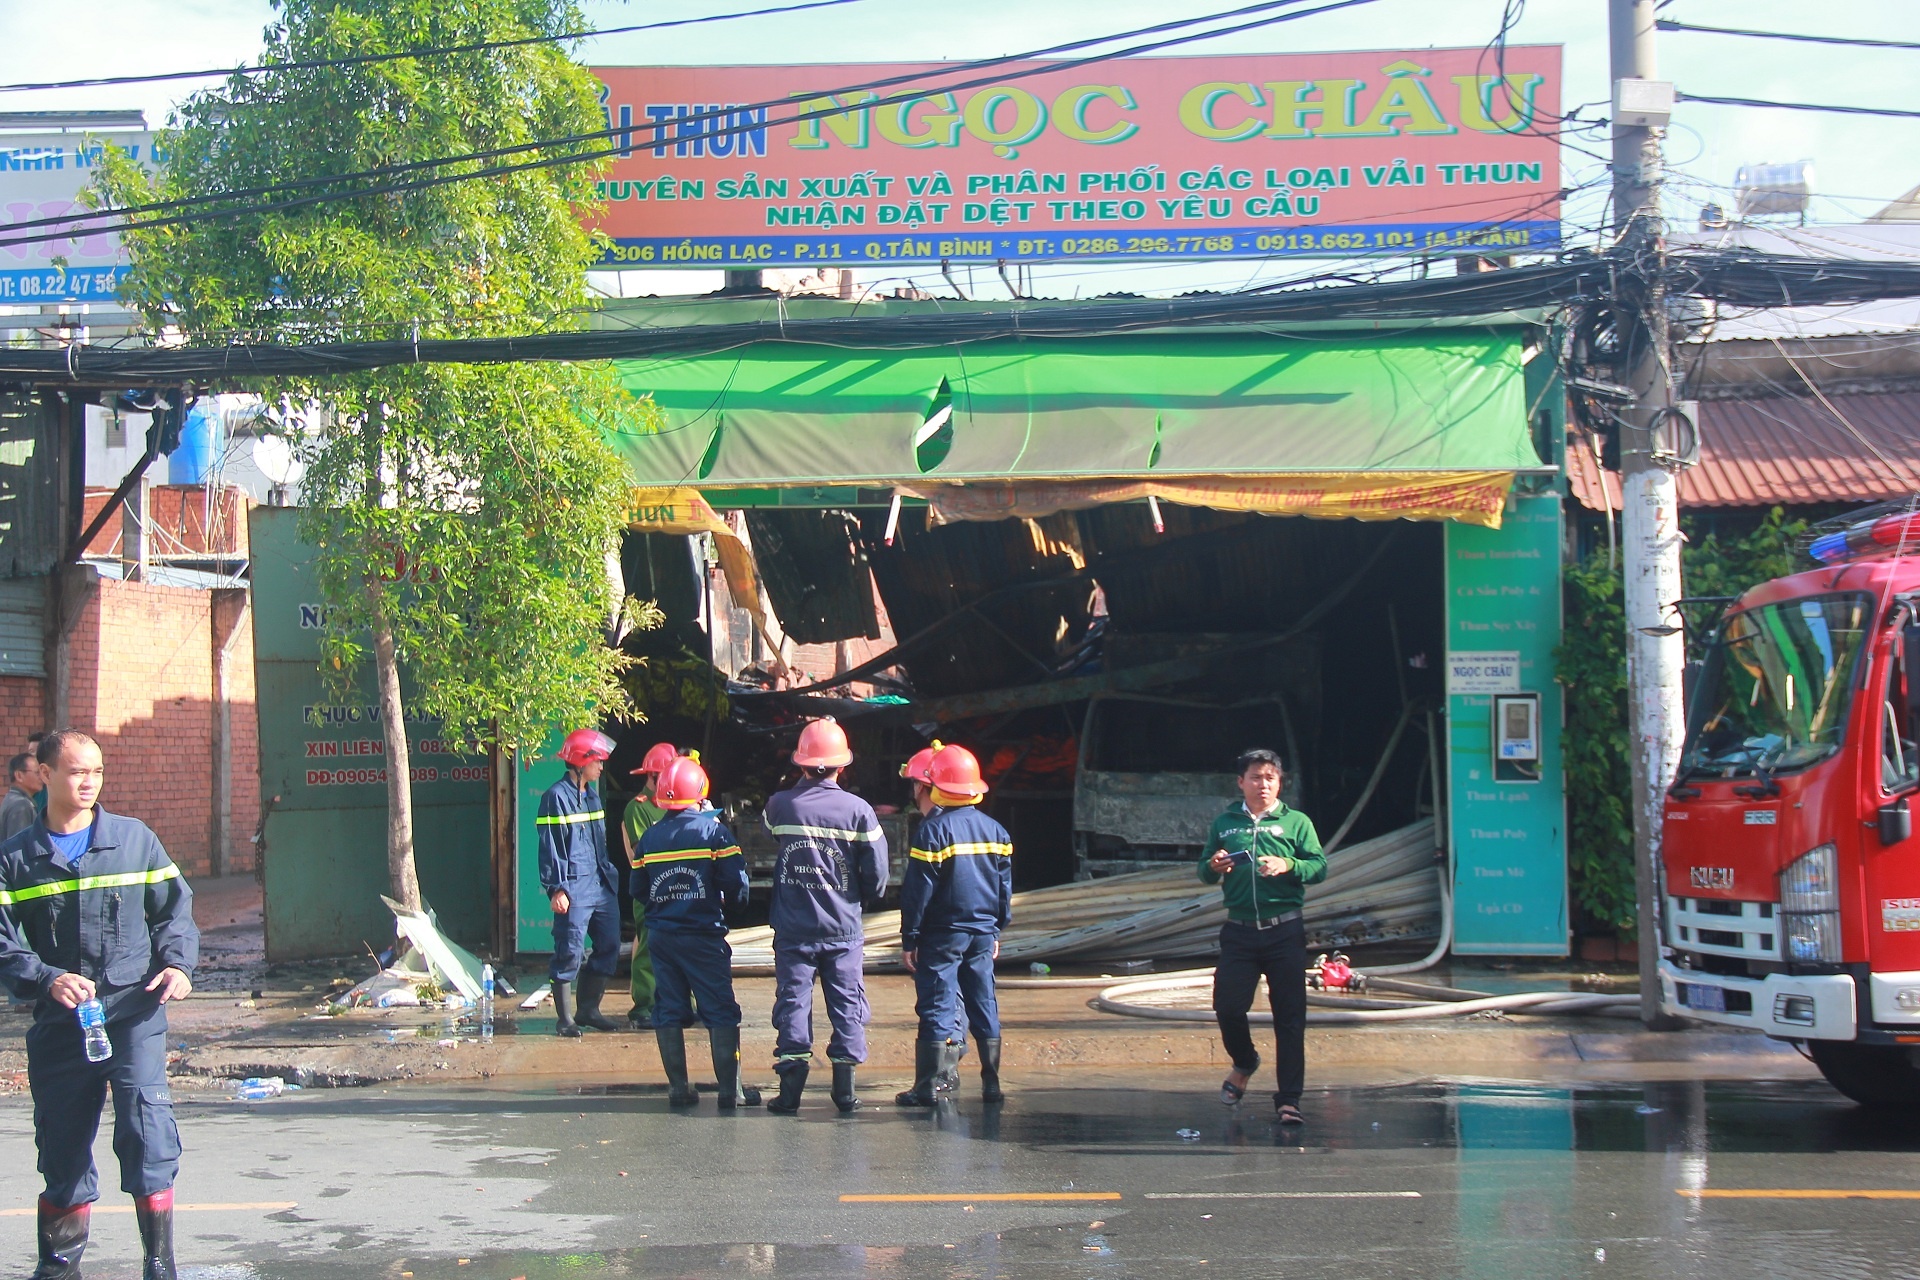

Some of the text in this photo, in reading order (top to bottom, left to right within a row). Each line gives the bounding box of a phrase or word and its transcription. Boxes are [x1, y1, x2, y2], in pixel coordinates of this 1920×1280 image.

[645, 103, 768, 159] THUN
[788, 84, 1139, 160] NGỌC
[1178, 58, 1545, 144] CHÂU
[715, 172, 788, 200] SẢN
[799, 169, 893, 199] XUẤT
[906, 170, 953, 198] VÀ
[967, 168, 1067, 196] PHÂN
[1079, 164, 1167, 194] PHỐI
[1178, 165, 1253, 192] CÁC
[1266, 166, 1351, 193] LOẠI
[1362, 158, 1426, 188] VẢI
[1437, 161, 1543, 185] THUN
[766, 189, 1321, 230] NHẬN ĐẶT DỆT THEO YÊU CẦU
[614, 245, 655, 261] 306
[662, 239, 722, 260] HỒNG
[730, 243, 772, 262] LẠC
[794, 242, 842, 260] P.11
[864, 238, 935, 260] Q.TÂN
[939, 237, 993, 258] BÌNH
[1018, 239, 1054, 257] ĐT:
[1061, 233, 1235, 254] 0286.296.7768
[1255, 231, 1415, 251] 0913.662.101
[20, 275, 66, 297] 08.22
[71, 274, 91, 295] 47
[1453, 664, 1513, 678] NGỌC CHÂU
[305, 741, 338, 757] XIN
[342, 738, 385, 756] LIÊN
